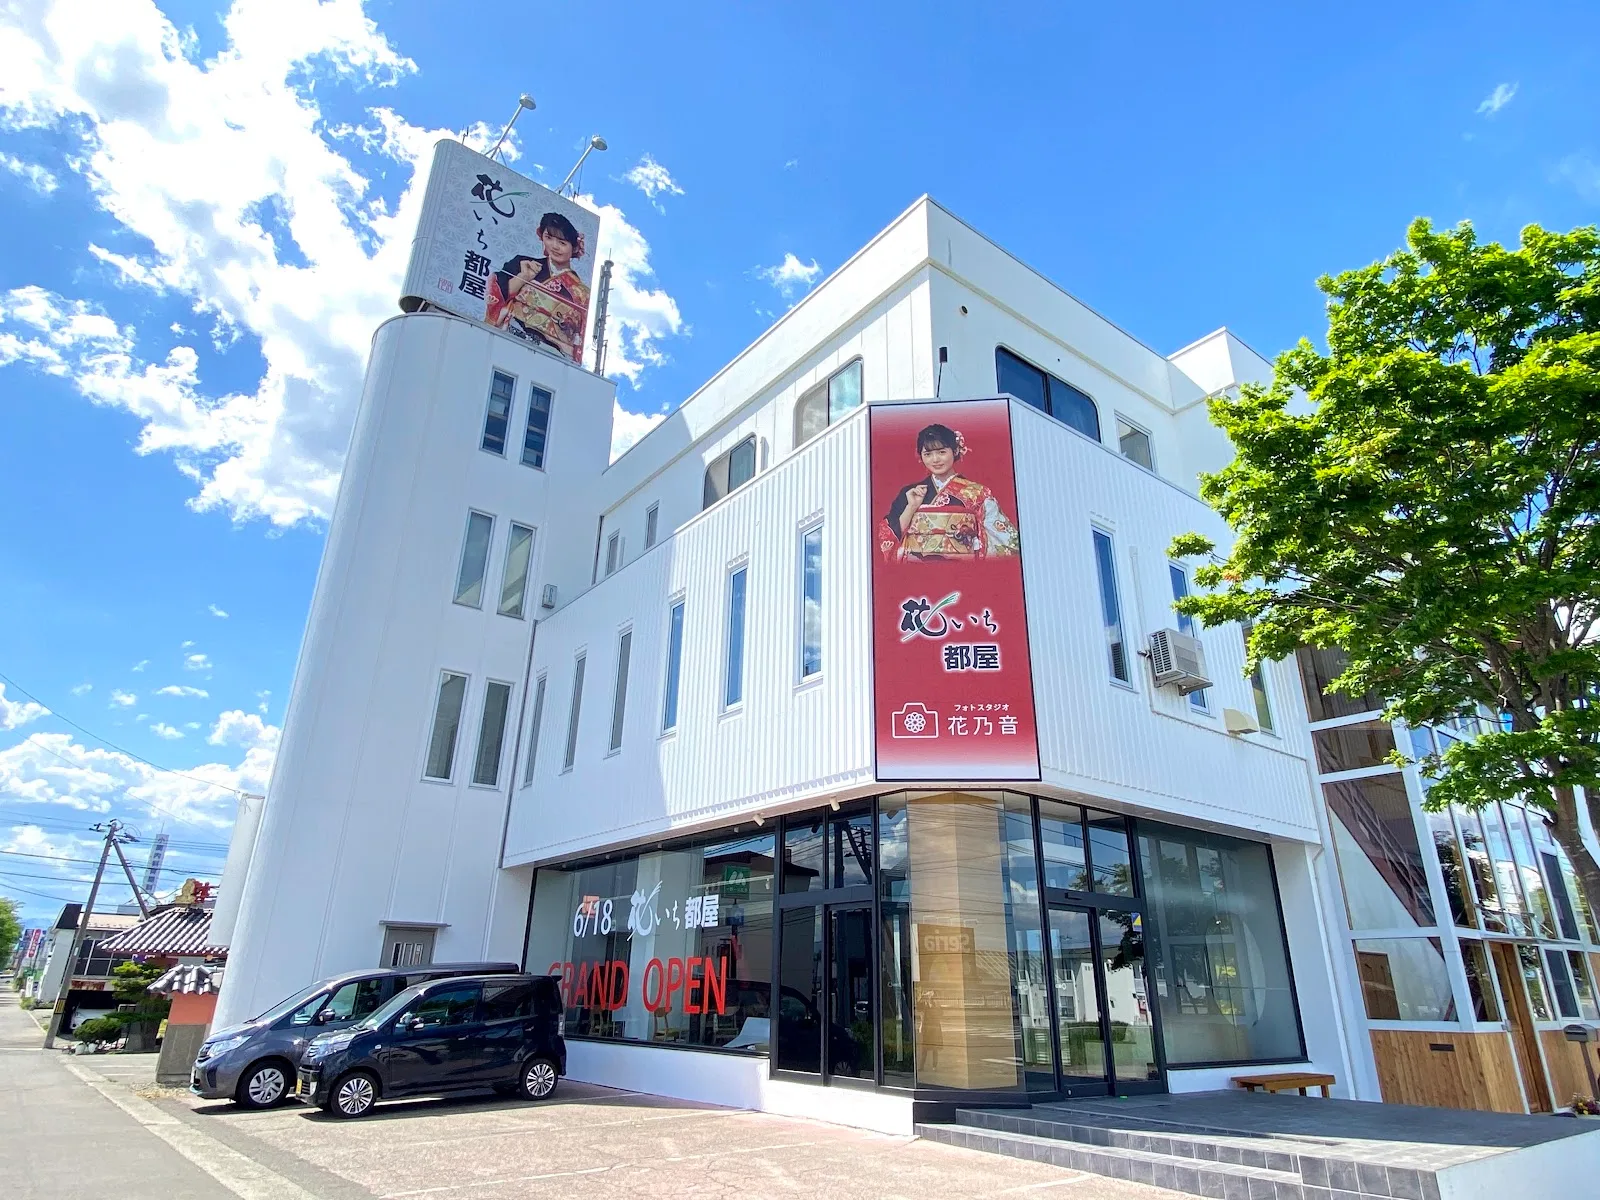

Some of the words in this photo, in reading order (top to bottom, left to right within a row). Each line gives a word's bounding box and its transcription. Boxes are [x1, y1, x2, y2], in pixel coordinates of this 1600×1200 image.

[901, 592, 998, 641] 花いち
[944, 645, 1000, 670] 都屋
[954, 703, 1010, 712] フォトスタジオ
[947, 715, 1019, 736] 花乃音
[573, 900, 613, 938] 6/18
[642, 956, 727, 1015] OPEN
